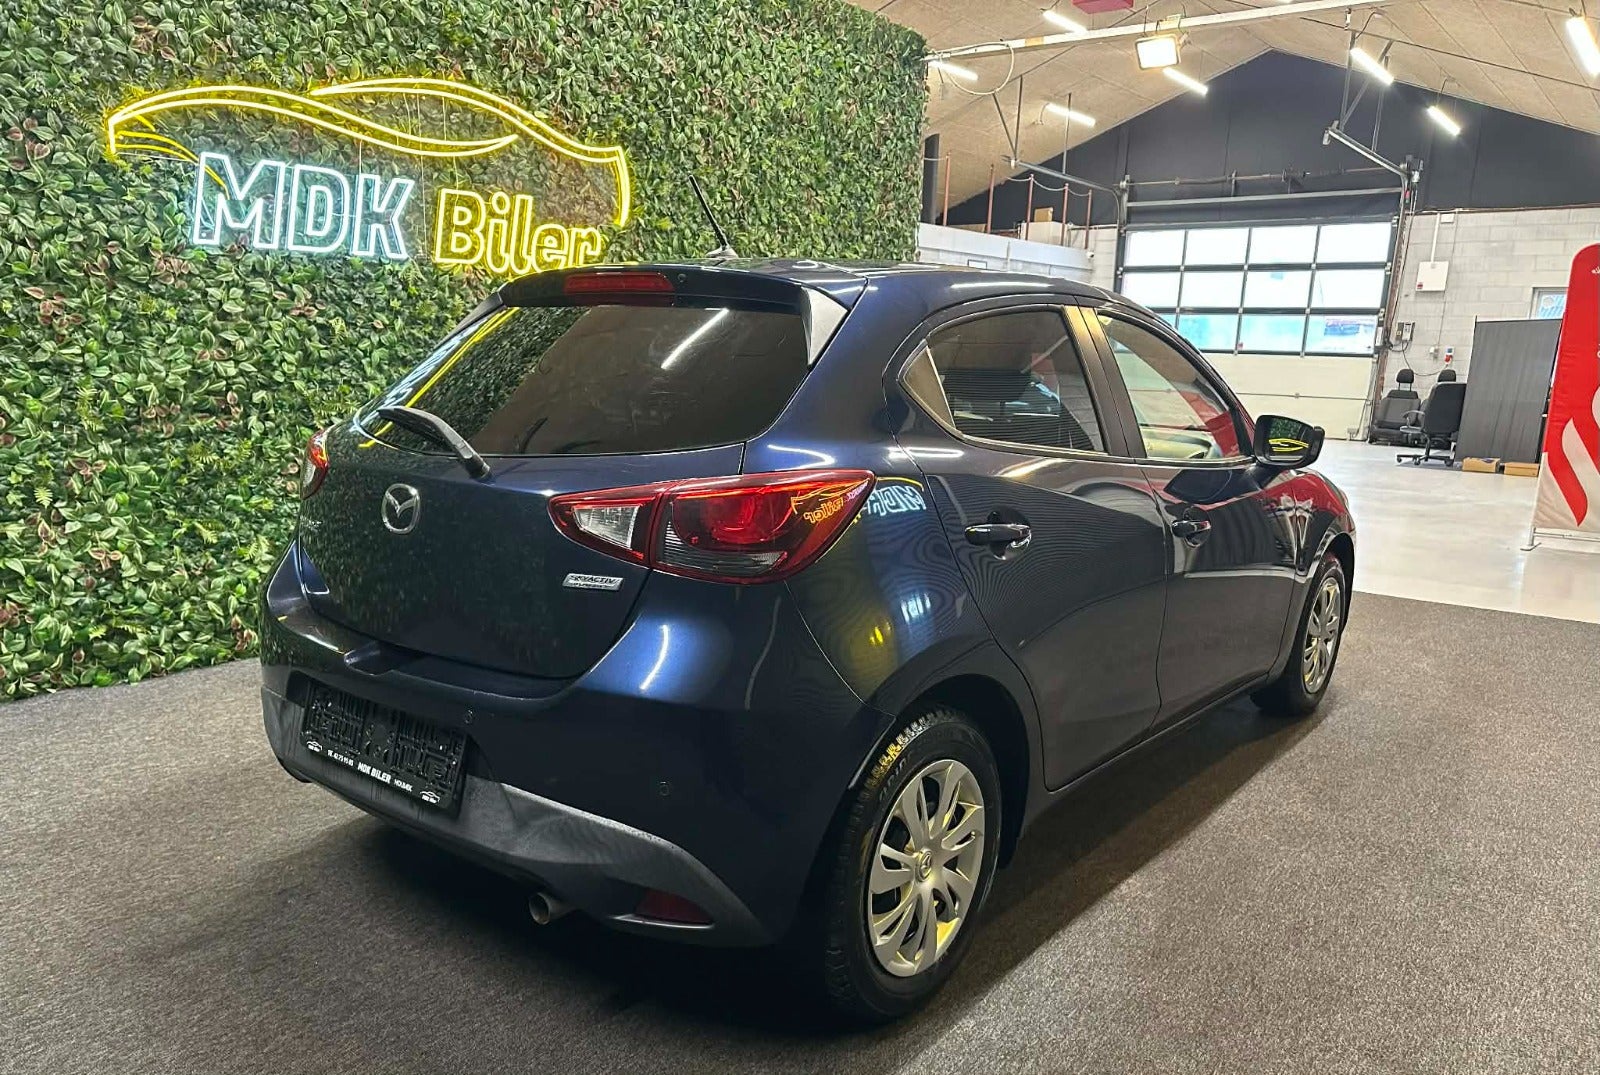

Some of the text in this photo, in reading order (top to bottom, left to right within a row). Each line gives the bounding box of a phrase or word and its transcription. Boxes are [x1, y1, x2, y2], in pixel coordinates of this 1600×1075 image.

[192, 151, 602, 275] MDK Biler
[357, 761, 371, 775] MDK
[370, 767, 392, 784] BILER
